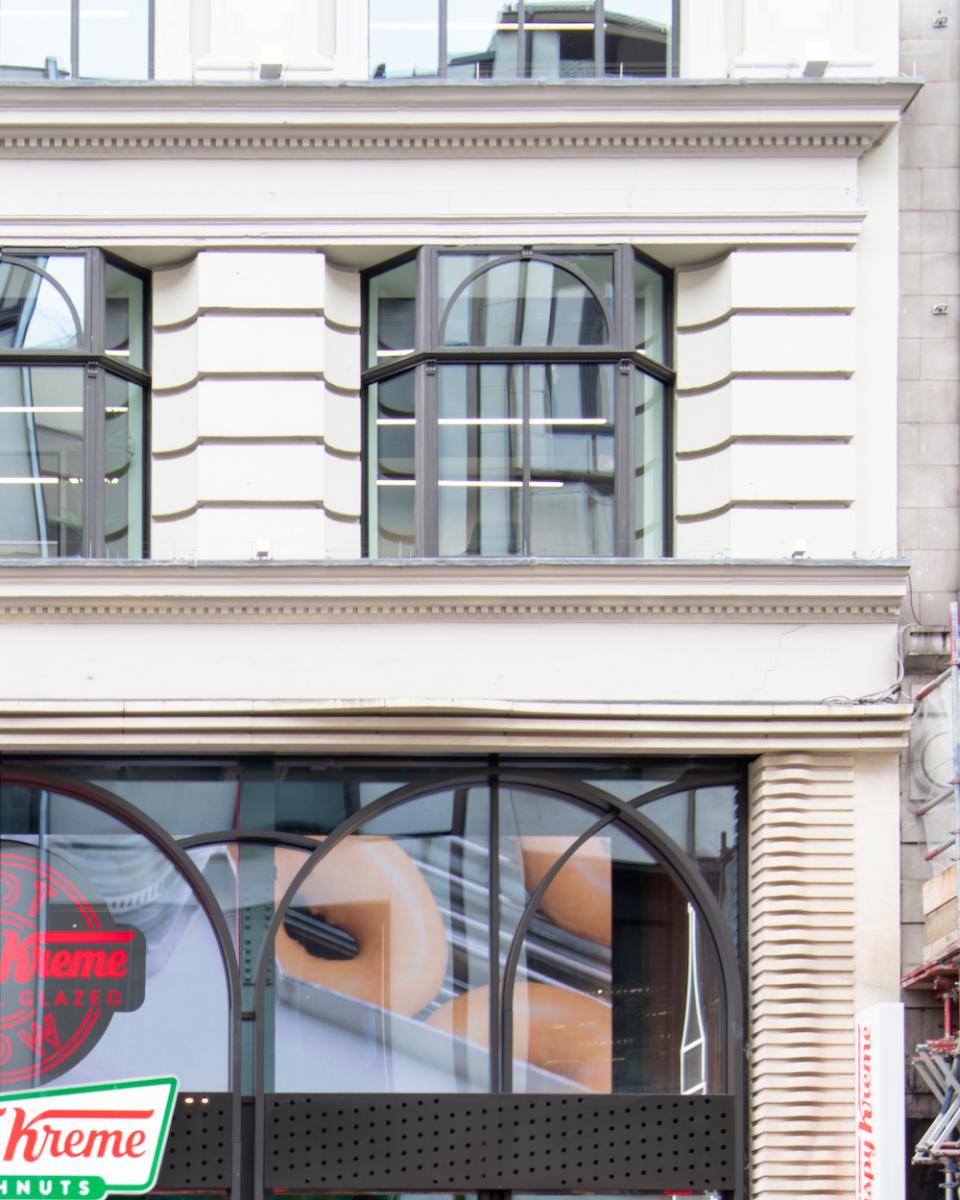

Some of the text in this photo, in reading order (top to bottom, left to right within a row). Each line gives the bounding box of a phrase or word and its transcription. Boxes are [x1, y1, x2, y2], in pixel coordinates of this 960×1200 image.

[1, 930, 136, 983] Kreme
[19, 989, 122, 1006] GLAZED
[858, 1023, 873, 1134] Kreme
[3, 1107, 154, 1161] Kreme
